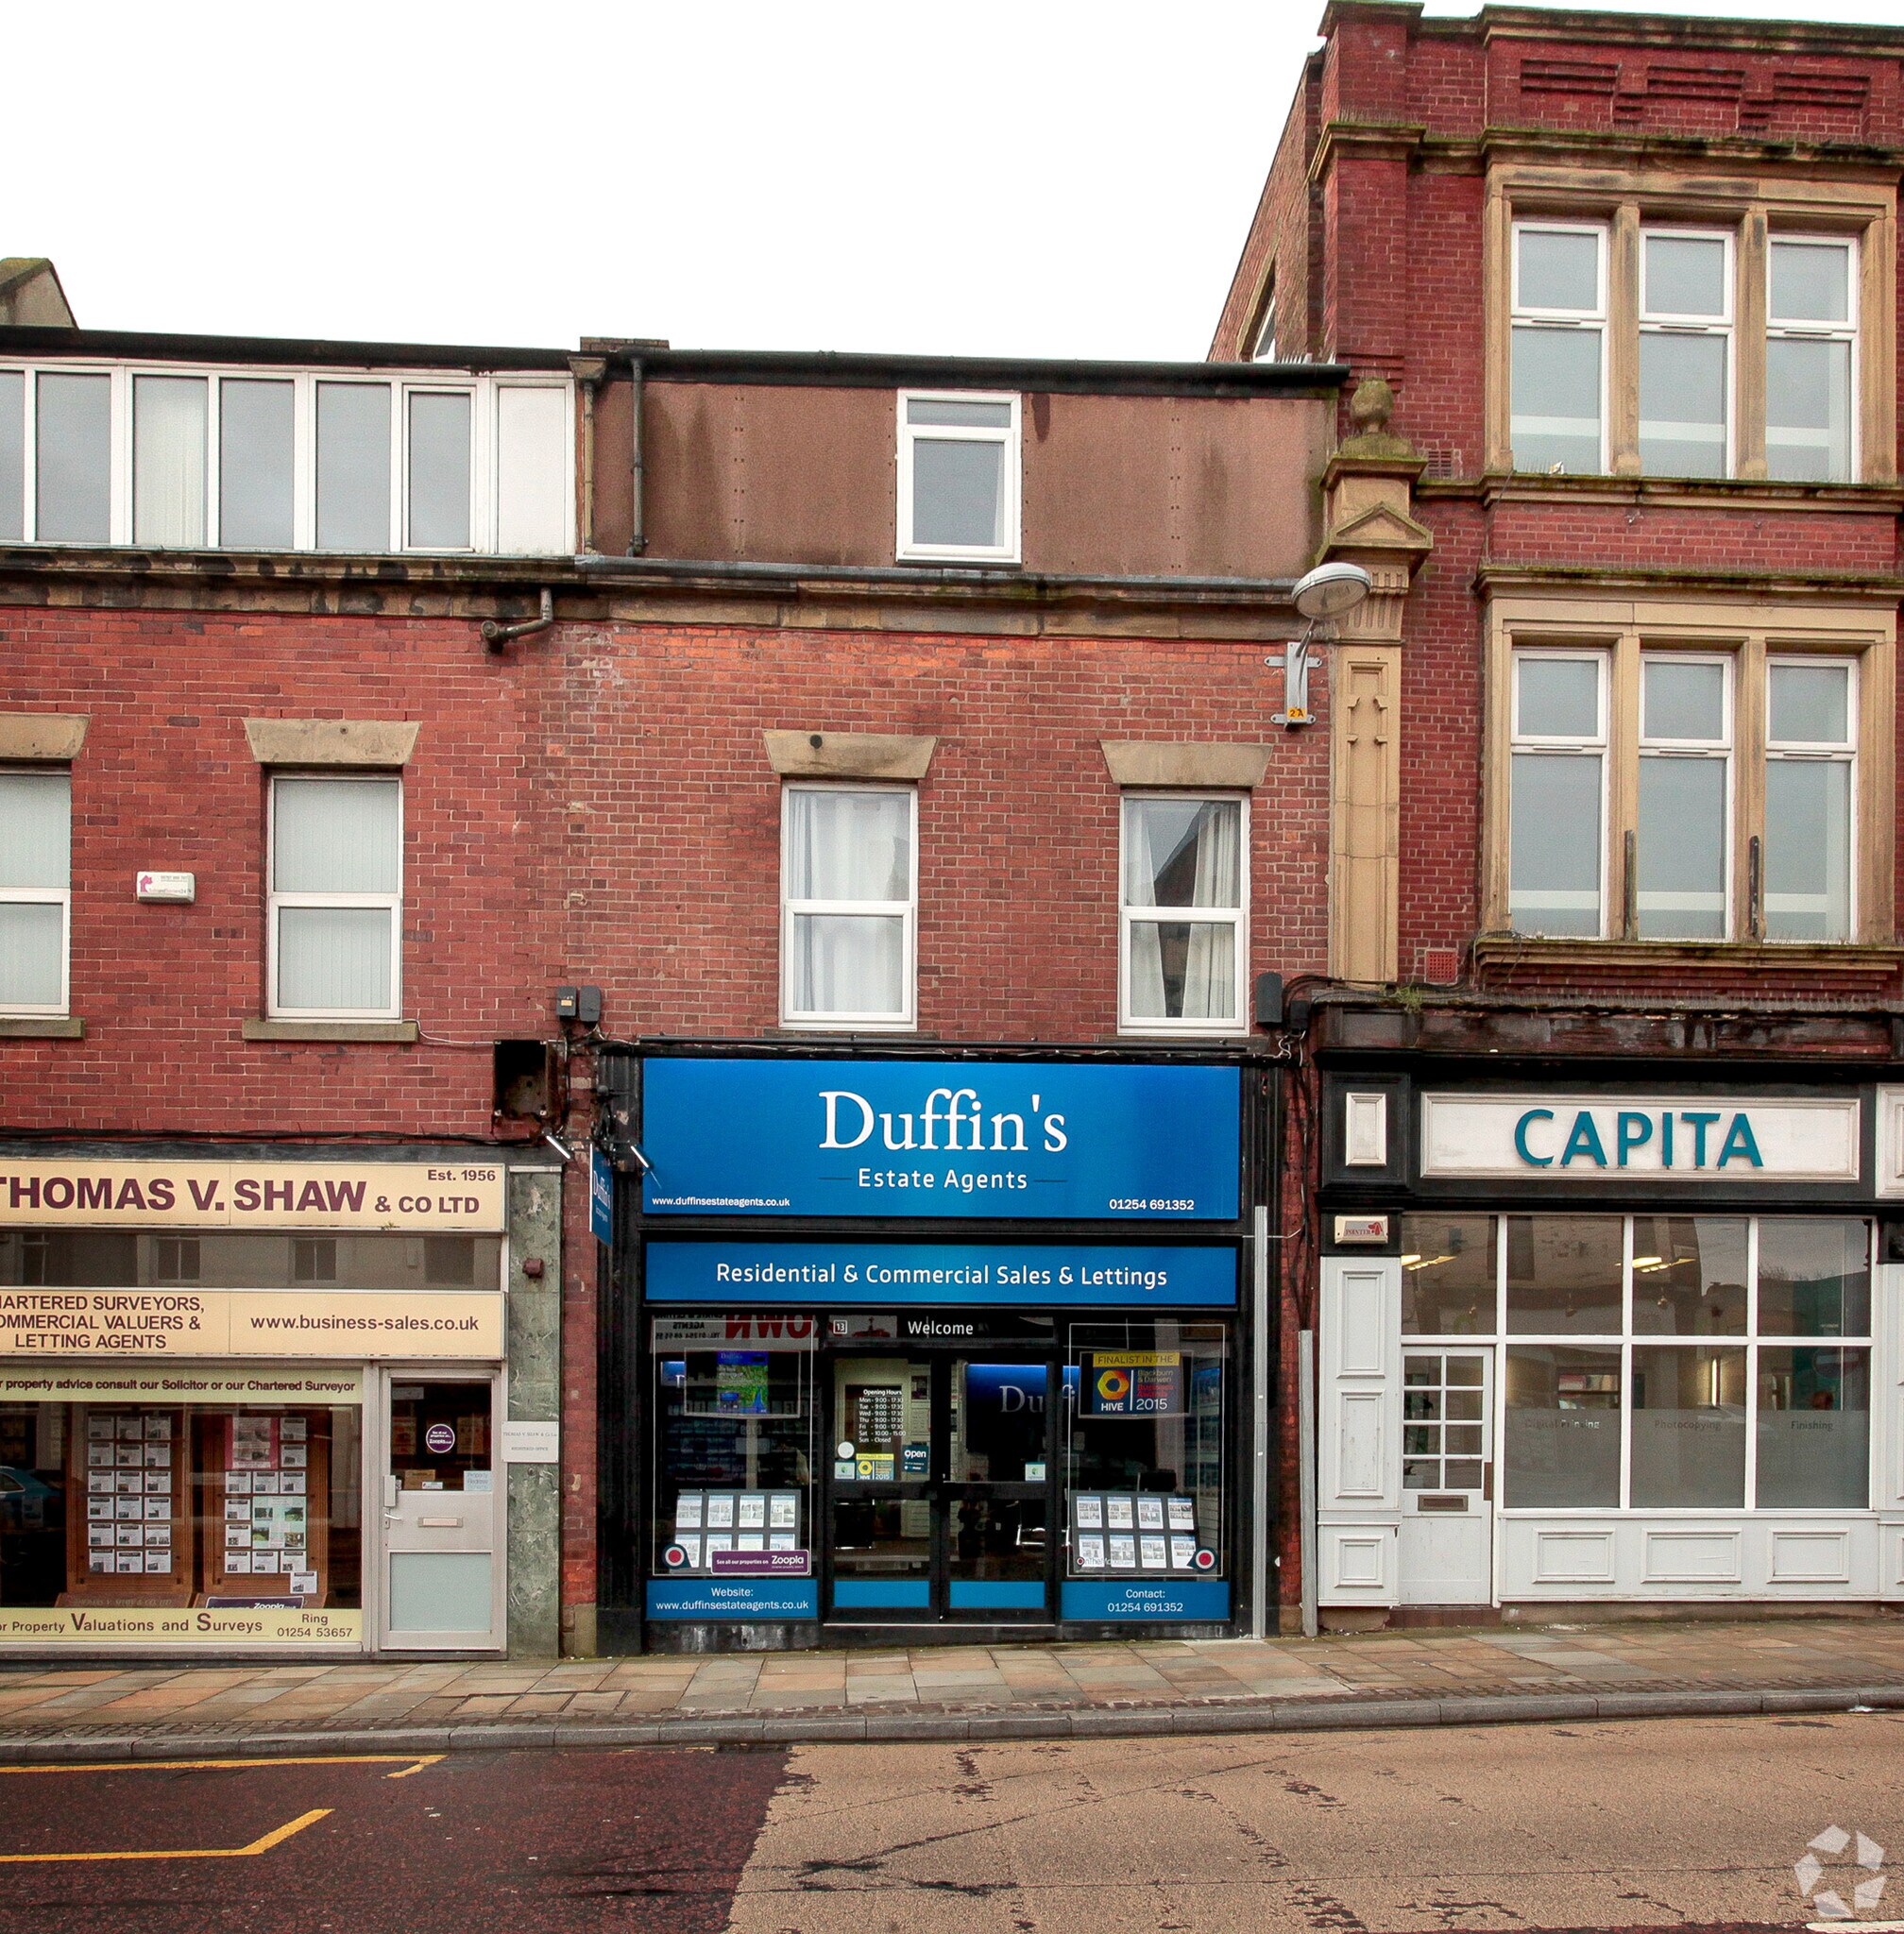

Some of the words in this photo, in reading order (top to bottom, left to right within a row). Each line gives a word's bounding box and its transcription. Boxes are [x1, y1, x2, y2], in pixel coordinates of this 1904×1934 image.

[818, 1088, 1068, 1152] Duffin's
[1514, 1109, 1764, 1167] CAPITA
[427, 1169, 456, 1181] Est.
[460, 1169, 496, 1181] 1956
[858, 1167, 935, 1188] Estate
[944, 1168, 1028, 1193] Agents
[186, 1179, 225, 1212] V.
[232, 1179, 367, 1213] SHAW
[374, 1196, 392, 1213] &
[398, 1196, 433, 1213] CO
[438, 1196, 480, 1214] LTD
[652, 1196, 790, 1209] www.duffinsestateagents.co.uk
[1109, 1198, 1147, 1210] 01254
[1149, 1198, 1195, 1211] 691352
[716, 1263, 836, 1283] Residential
[842, 1264, 858, 1283] &
[865, 1264, 989, 1284] Commercial
[996, 1264, 1051, 1285] Sales
[1058, 1265, 1074, 1285] &
[1080, 1266, 1167, 1290] Lettings
[0, 1295, 88, 1310] ARTERED
[93, 1296, 205, 1314] SURVEYORS,
[104, 1315, 184, 1331] VALUERS
[189, 1315, 201, 1331] &
[250, 1314, 480, 1331] www.business-sales.co.uk
[836, 1322, 845, 1332] 13
[908, 1320, 974, 1335] Welcome
[15, 1333, 91, 1349] LETTING
[95, 1333, 167, 1349] AGENTS
[1097, 1355, 1141, 1365] FINALIST
[1142, 1355, 1152, 1364] IN
[6, 1379, 54, 1391] property
[56, 1379, 93, 1389] advice
[95, 1379, 137, 1390] consult
[140, 1382, 159, 1390] our
[162, 1380, 209, 1390] Solicitor
[211, 1382, 223, 1390] or
[226, 1383, 245, 1391] our
[247, 1380, 302, 1391] Chartered
[305, 1381, 355, 1393] Surveyor
[1100, 1402, 1124, 1411] HIVE
[1135, 1398, 1167, 1411] 2015
[1791, 1420, 1833, 1432] Finishing
[771, 1554, 805, 1566] Zoopla
[710, 1587, 754, 1597] Website:
[1125, 1588, 1165, 1599] Contact:
[655, 1601, 809, 1611] www.duffinsestateagents.co.uk
[1107, 1603, 1141, 1612] 01254
[1143, 1603, 1183, 1612] 691352
[12, 1620, 65, 1634] Property
[71, 1613, 154, 1631] Valuations
[162, 1620, 189, 1631] and
[196, 1613, 263, 1634] Surveys
[301, 1613, 329, 1625] Ring
[277, 1627, 312, 1637] 01254
[315, 1627, 353, 1637] 53657
